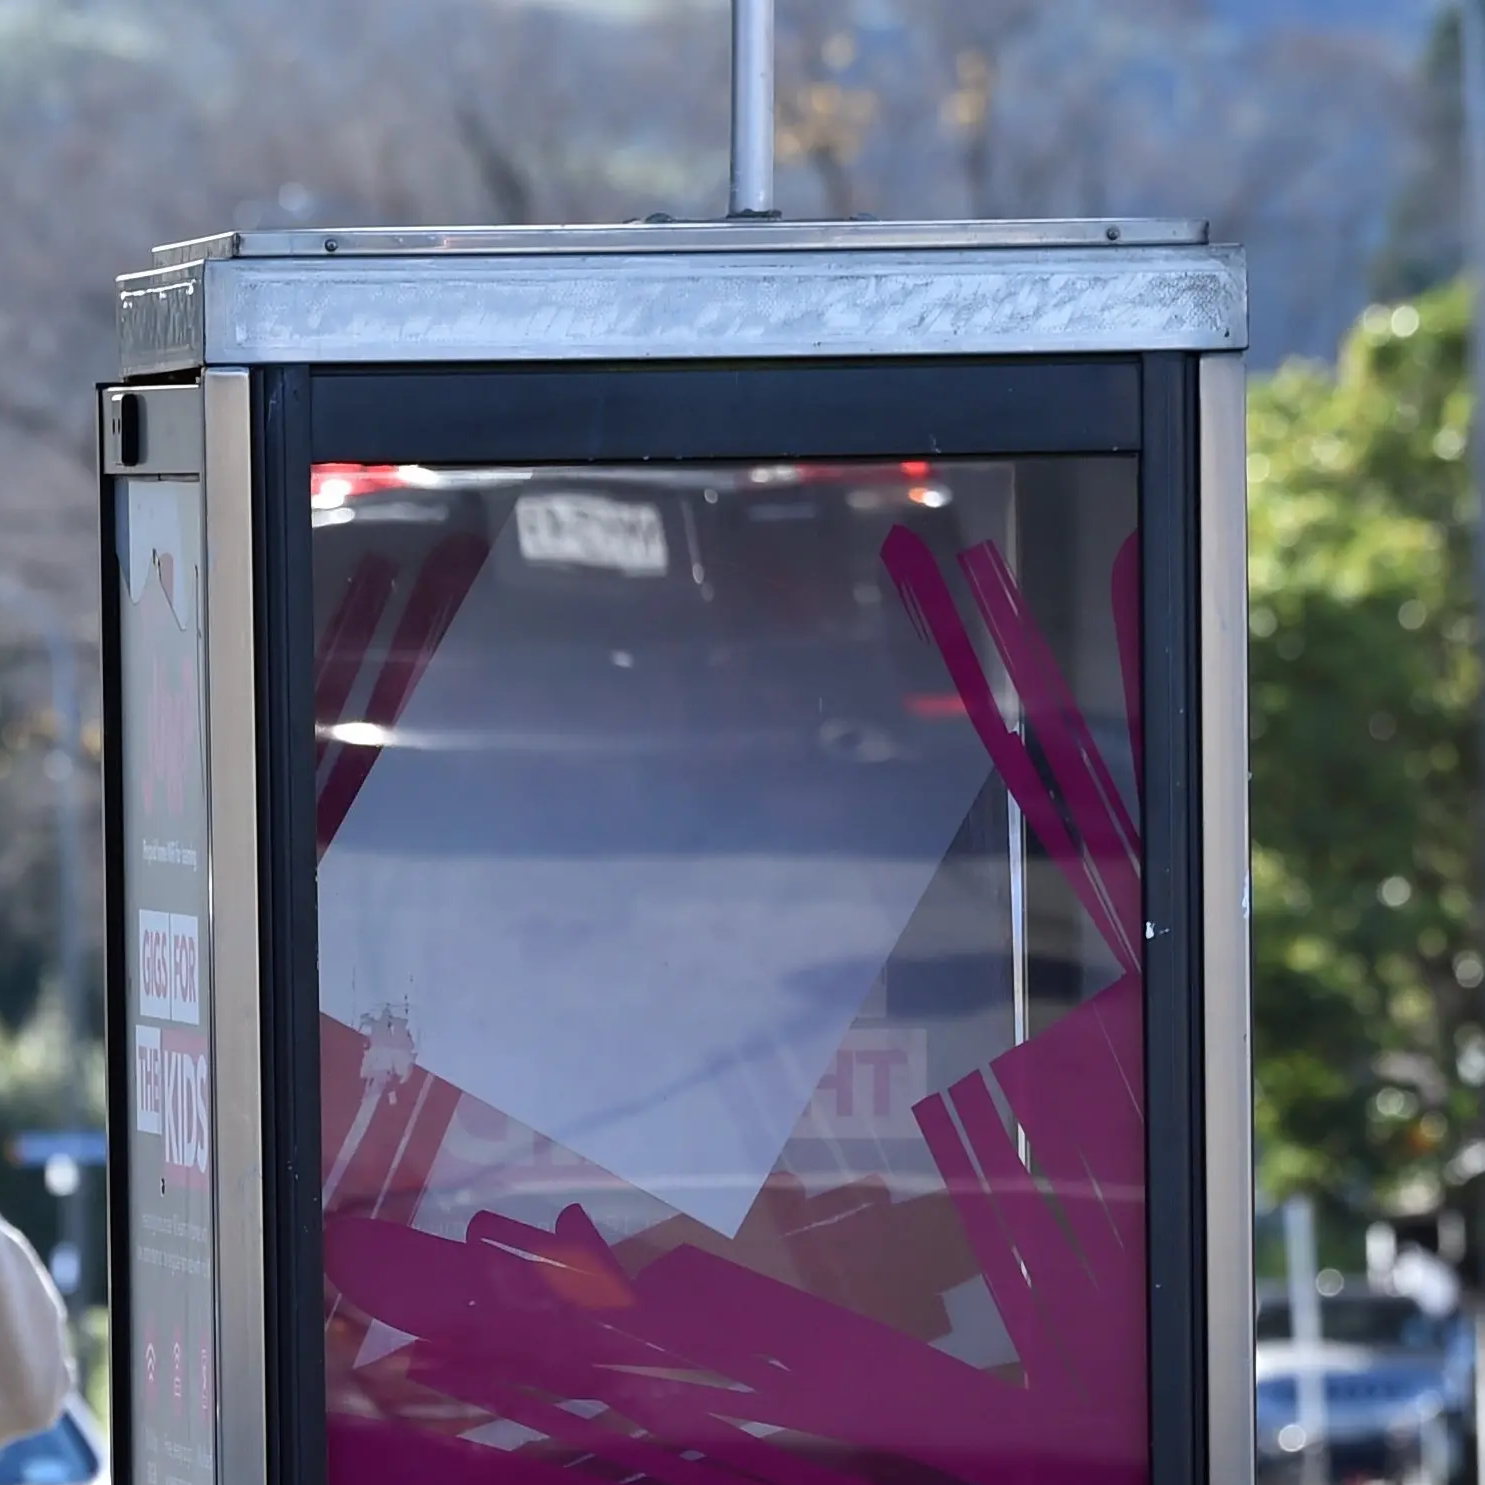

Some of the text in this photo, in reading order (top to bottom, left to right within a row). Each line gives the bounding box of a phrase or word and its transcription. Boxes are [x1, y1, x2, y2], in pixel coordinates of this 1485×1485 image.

[142, 929, 197, 1003] GIGS FOR
[138, 1044, 207, 1174] THE KIDS
